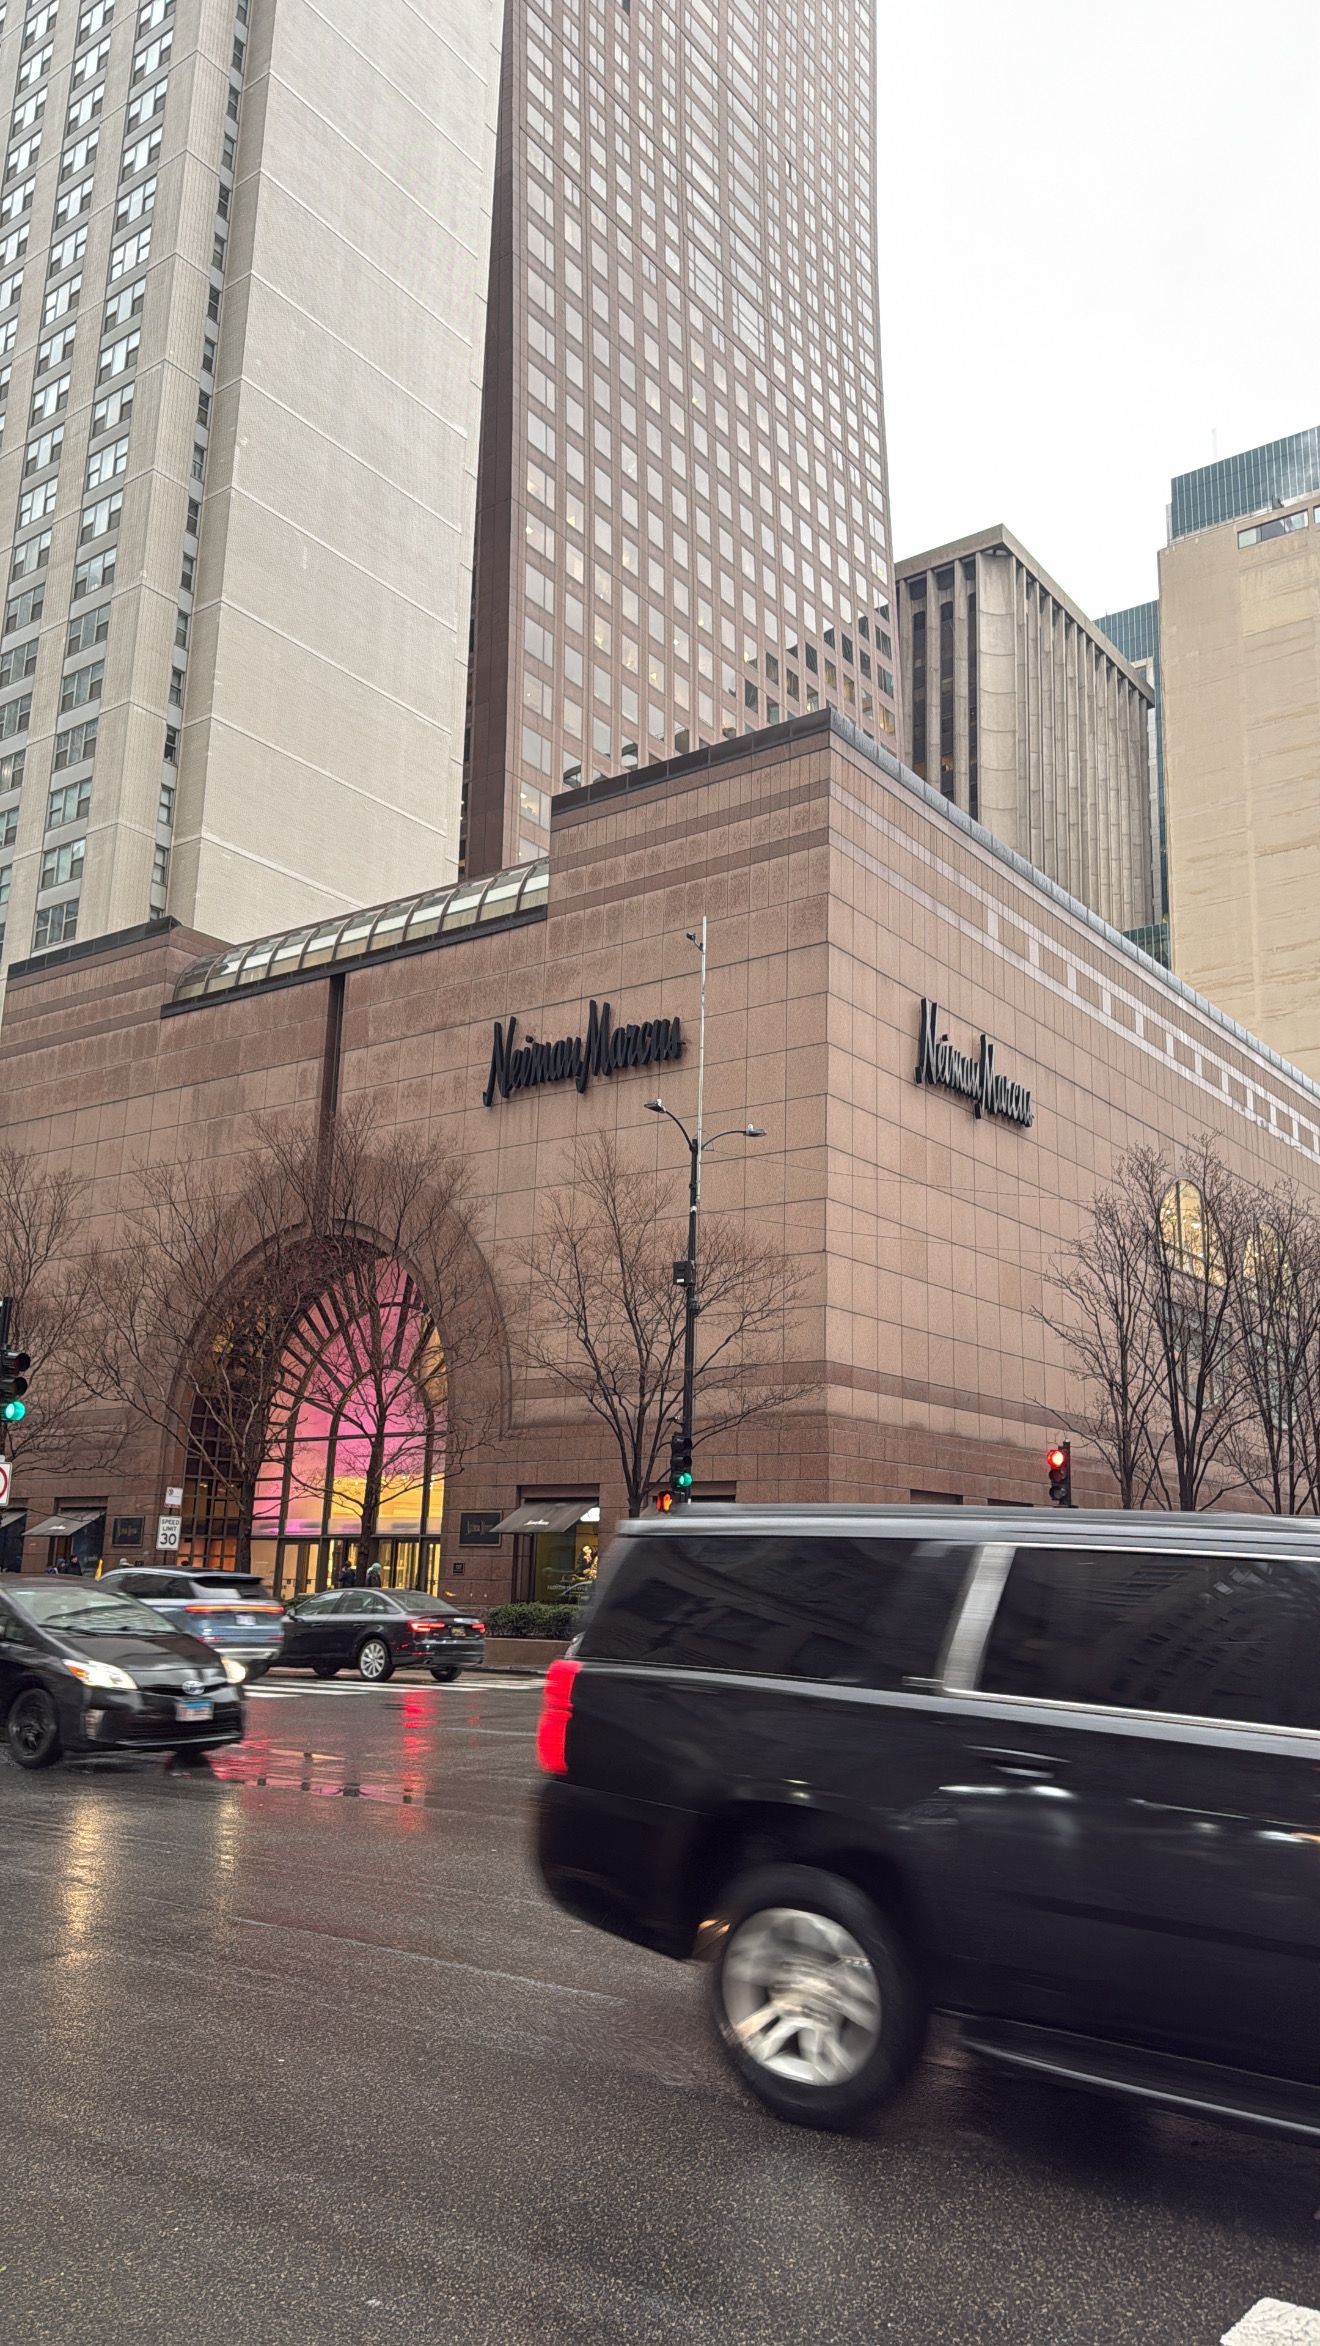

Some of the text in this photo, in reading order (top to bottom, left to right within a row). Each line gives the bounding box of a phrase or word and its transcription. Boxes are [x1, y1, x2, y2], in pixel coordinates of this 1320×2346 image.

[483, 999, 687, 1107] Neiman Marcus
[915, 997, 1035, 1128] Neiman Marcus
[159, 1532, 177, 1546] 30
[161, 1518, 180, 1526] SPEED
